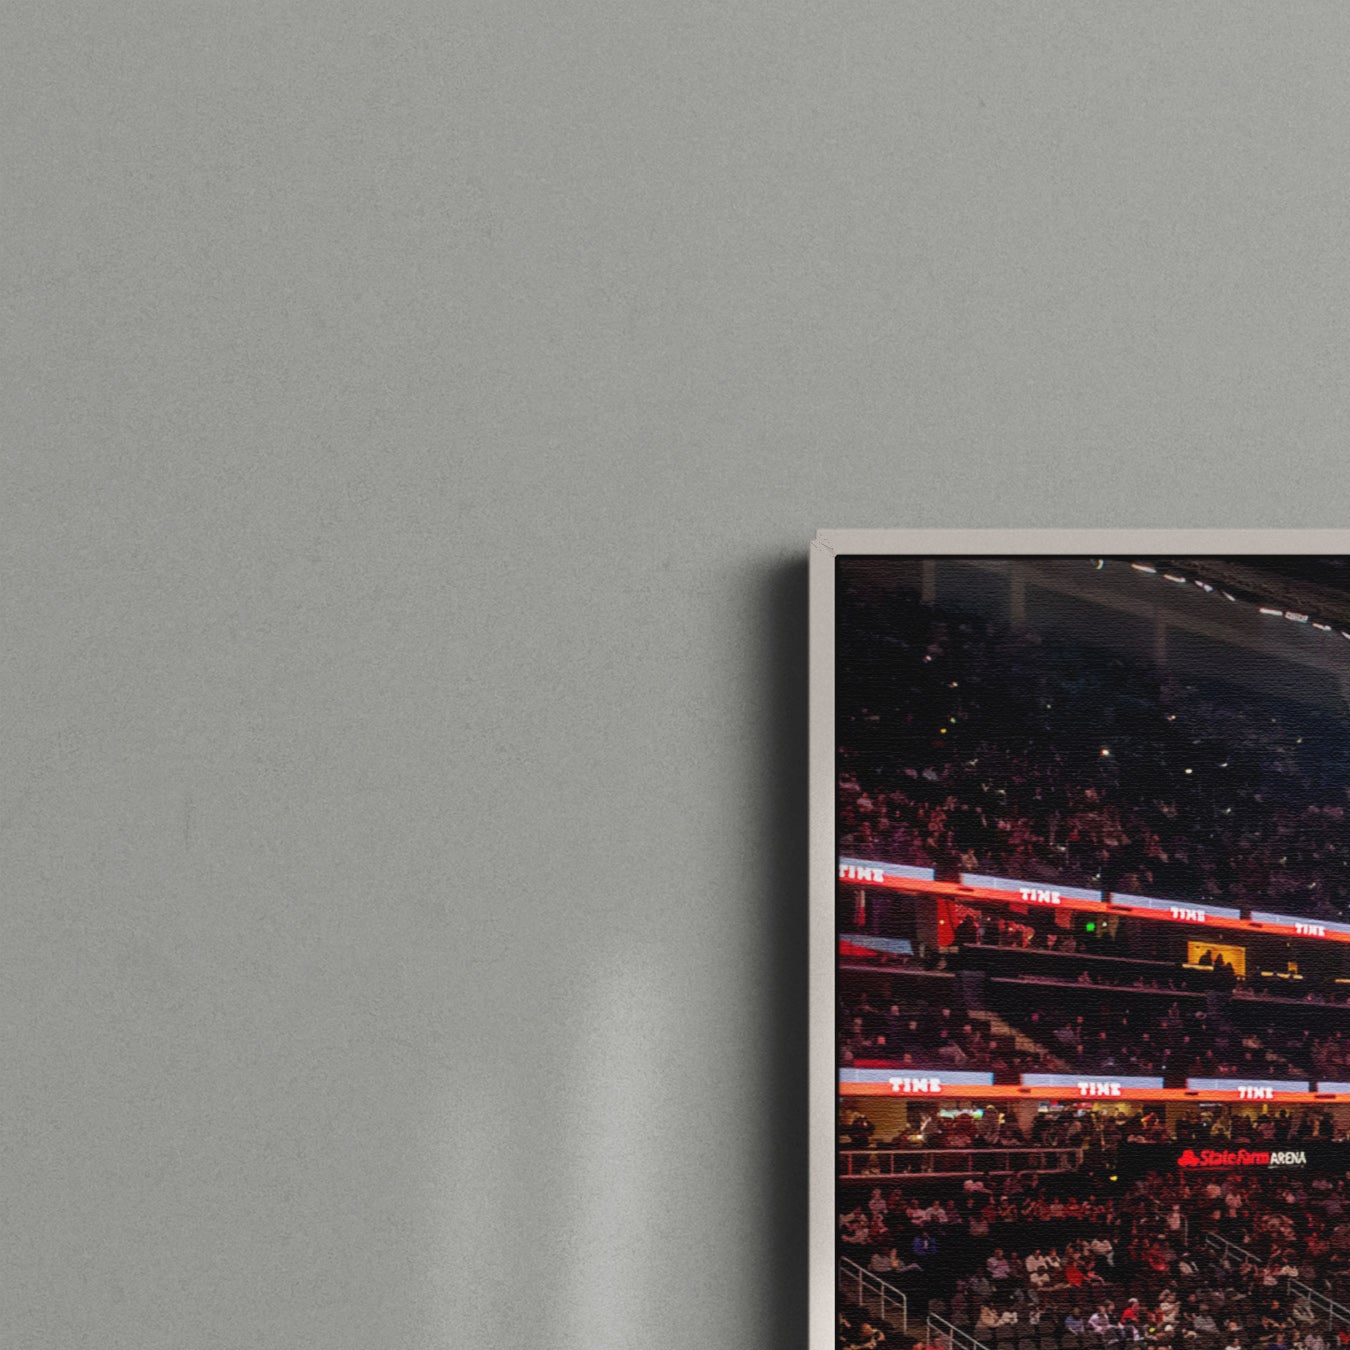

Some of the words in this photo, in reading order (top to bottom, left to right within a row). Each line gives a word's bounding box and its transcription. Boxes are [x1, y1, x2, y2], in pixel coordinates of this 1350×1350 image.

[1019, 888, 1061, 905] TIME
[1170, 906, 1206, 922] TIME
[1294, 922, 1326, 937] TIME
[889, 1077, 942, 1093] TIME
[1077, 1082, 1121, 1096] TIME
[1237, 1086, 1274, 1099] TIME
[1270, 1151, 1307, 1166] ARENA
